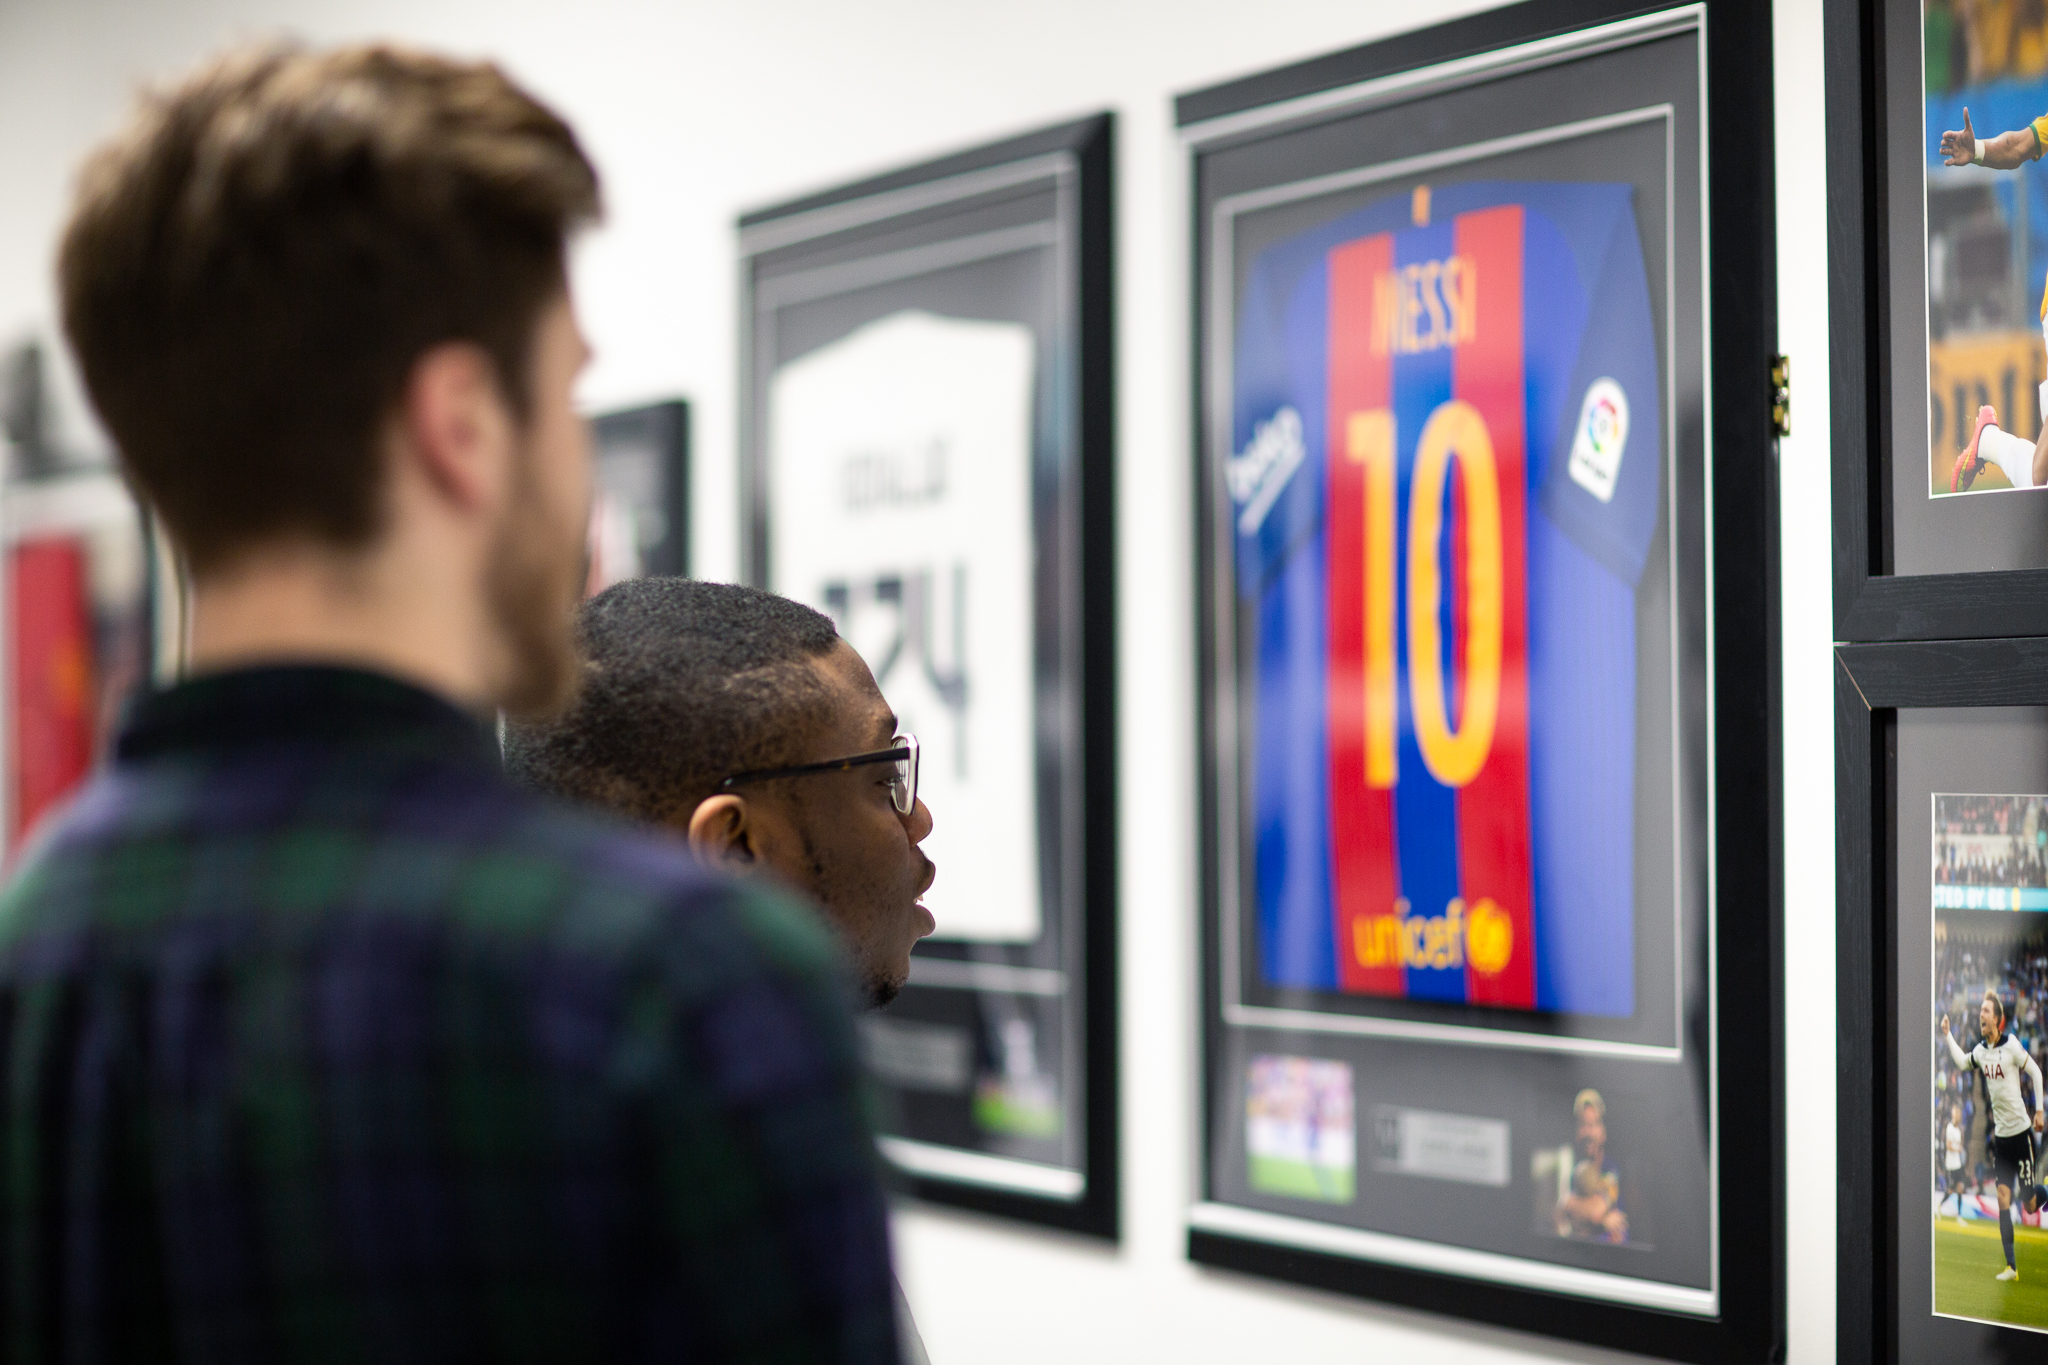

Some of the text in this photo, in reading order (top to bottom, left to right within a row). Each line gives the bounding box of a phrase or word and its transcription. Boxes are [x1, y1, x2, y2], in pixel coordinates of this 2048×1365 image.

[1370, 255, 1476, 356] MESSI
[1346, 400, 1502, 788] 10
[1353, 897, 1464, 970] unicef
[1984, 1063, 2005, 1080] AIA
[2018, 1159, 2031, 1179] 23
